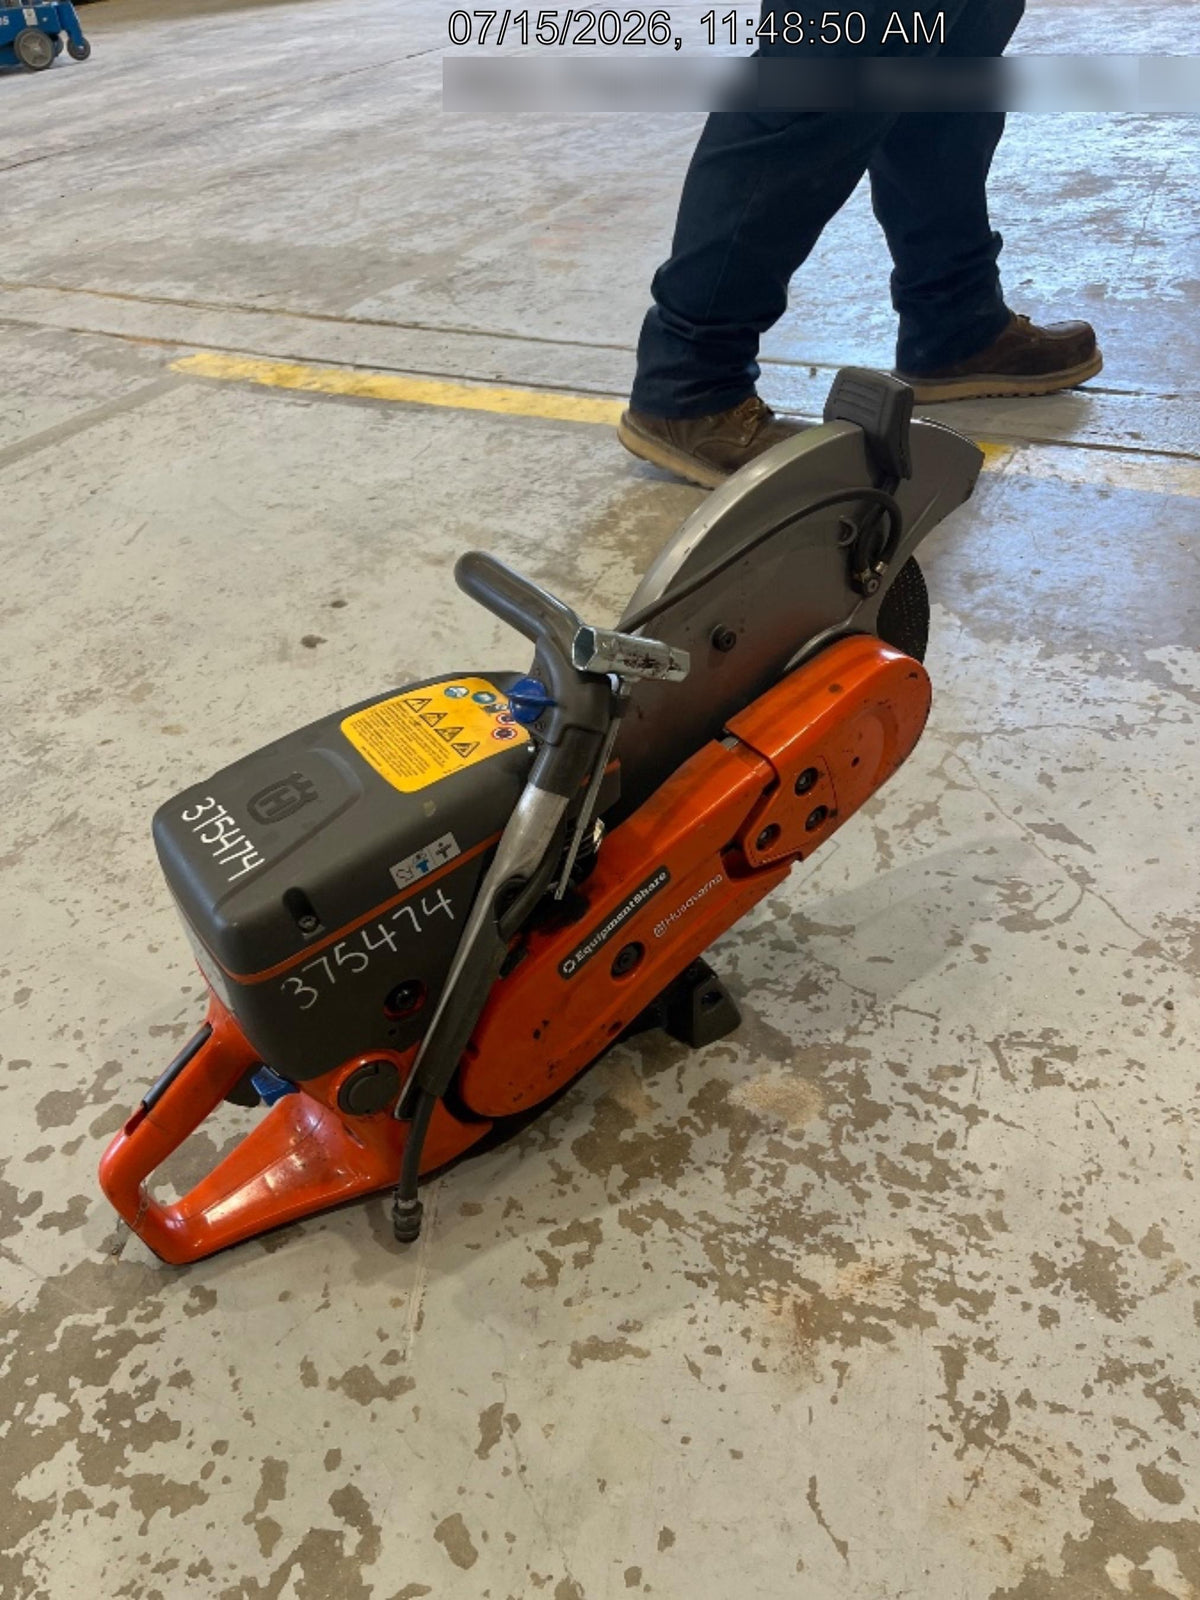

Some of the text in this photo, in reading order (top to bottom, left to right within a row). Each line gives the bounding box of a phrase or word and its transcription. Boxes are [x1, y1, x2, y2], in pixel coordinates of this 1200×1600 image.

[181, 796, 266, 882] 375474
[574, 871, 667, 962] EquipmentShare
[664, 873, 723, 926] Husqvarna
[280, 888, 455, 1010] 375474
